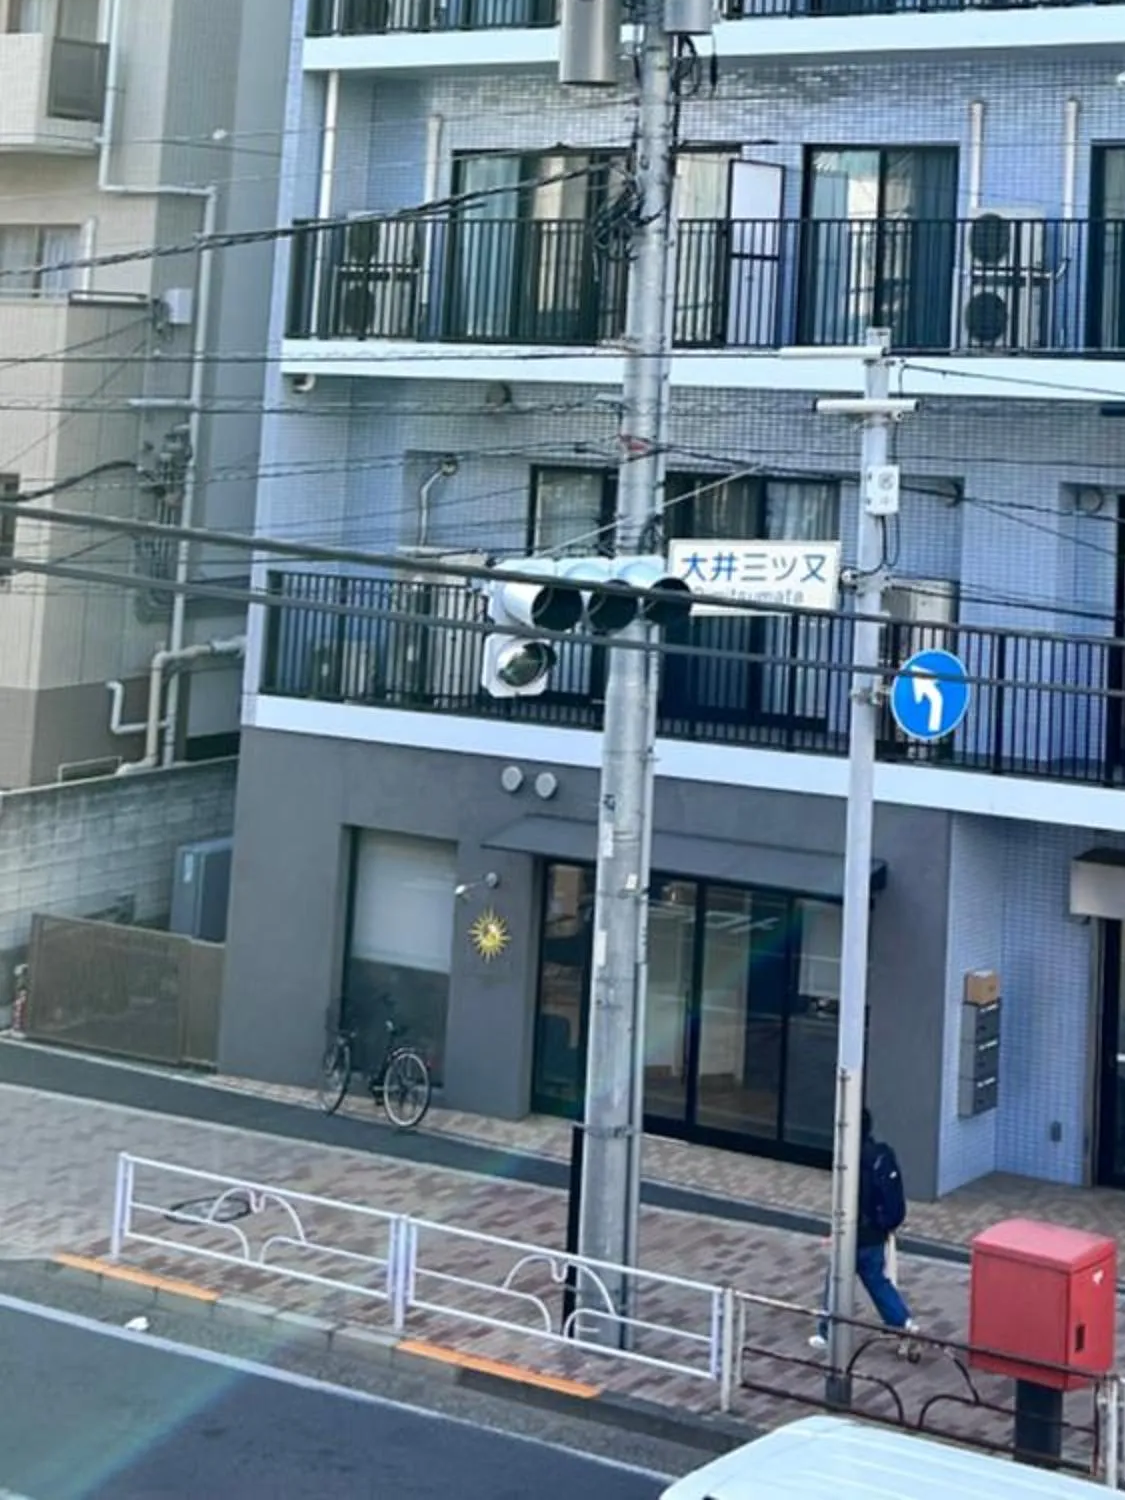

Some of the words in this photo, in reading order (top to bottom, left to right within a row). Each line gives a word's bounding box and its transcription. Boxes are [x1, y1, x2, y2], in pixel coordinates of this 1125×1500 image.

[681, 551, 827, 583] 大井三ツ又
